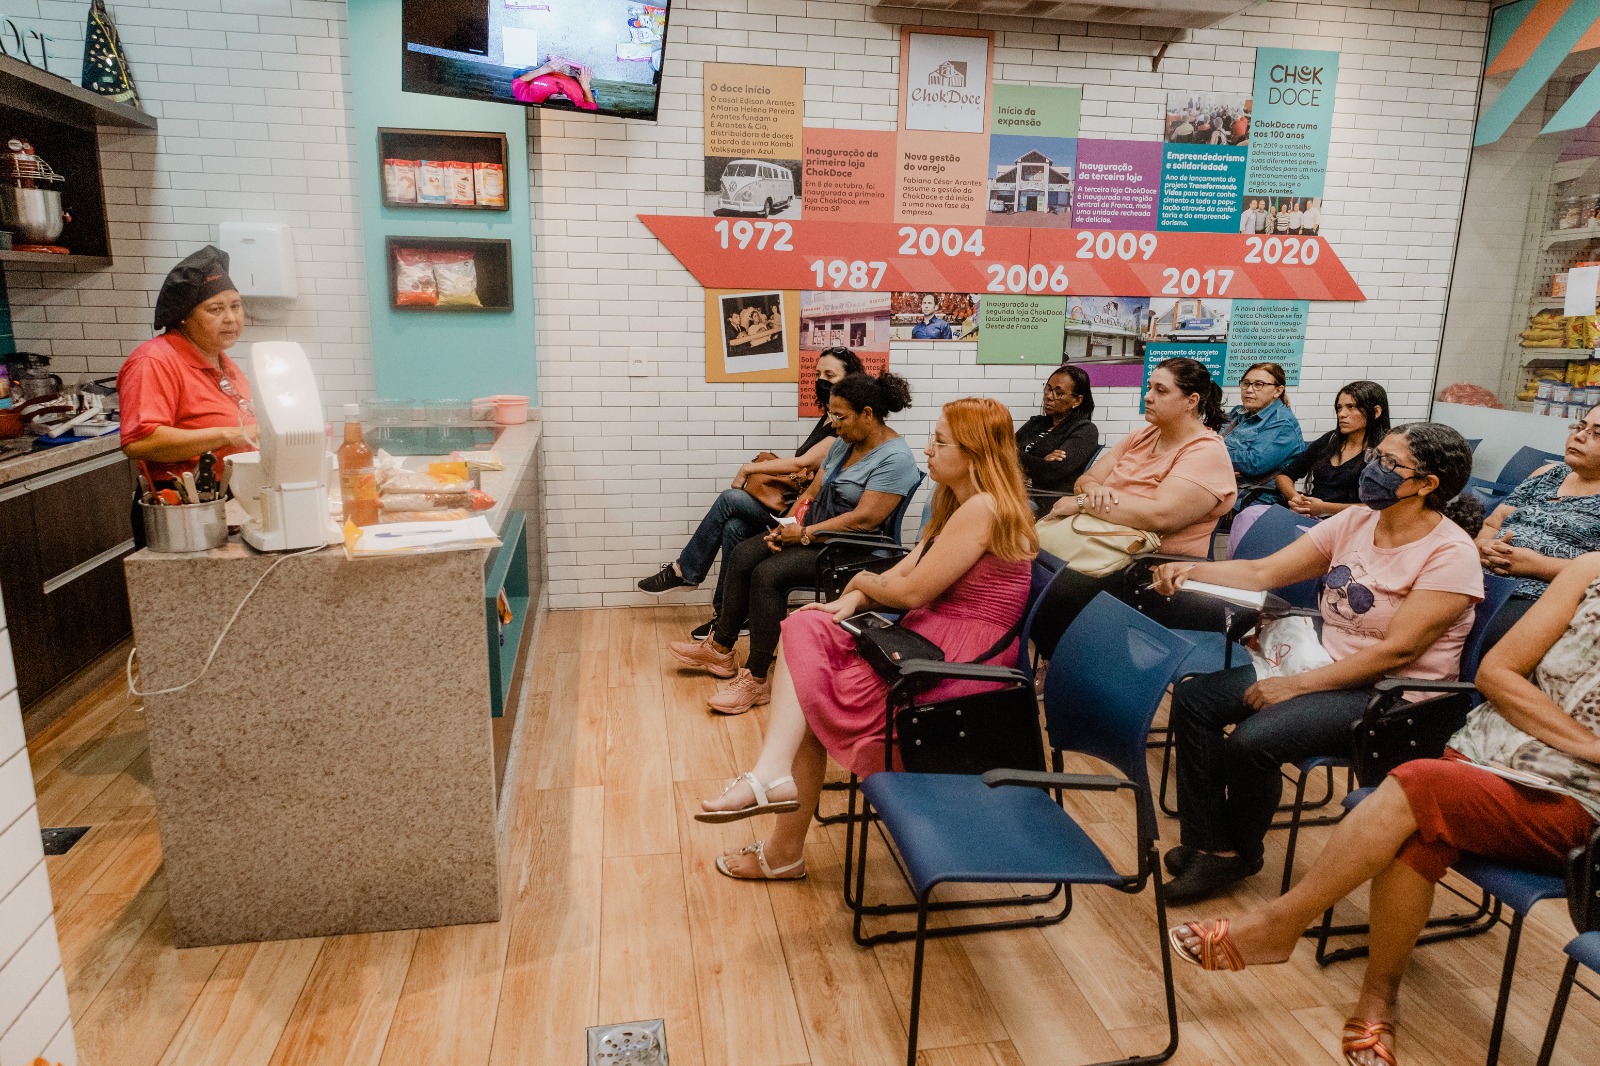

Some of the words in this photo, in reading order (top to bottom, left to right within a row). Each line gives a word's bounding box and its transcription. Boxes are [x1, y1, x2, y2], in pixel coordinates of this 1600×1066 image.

[720, 83, 742, 92] doce
[745, 85, 770, 94] início
[912, 88, 980, 104] ChokDoce
[1268, 87, 1321, 106] DOCE
[765, 98, 795, 106] Arantes
[998, 105, 1022, 114] Início
[1024, 106, 1035, 115] da
[710, 112, 740, 120] Arantes
[997, 117, 1041, 128] expansão
[1254, 120, 1295, 128] ChokDoce
[710, 129, 759, 137] distribuidora
[710, 146, 755, 155] Volkswagen
[806, 146, 864, 158] Inauguração
[904, 152, 927, 160] Nova
[929, 153, 960, 164] gestão
[1166, 151, 1245, 163] Empreendedorismo
[806, 157, 845, 168] primeira
[848, 159, 864, 169] loja
[917, 163, 945, 173] varejo
[1079, 161, 1133, 173] Inauguração
[1172, 161, 1228, 170] solidariedade
[805, 168, 852, 177] ChokDoce
[1091, 171, 1125, 180] terceira
[1126, 173, 1142, 183] loja
[903, 176, 931, 184] Fabiano
[1188, 174, 1226, 183] lançamento
[937, 186, 961, 194] gestão
[1164, 181, 1187, 190] projeto
[1188, 182, 1237, 190] Transformando
[804, 189, 846, 197] inaugurada
[902, 192, 937, 200] ChokDoce
[1082, 193, 1120, 201] inaugurada
[1131, 195, 1152, 203] região
[804, 196, 817, 204] loja
[714, 220, 794, 251] 1972
[898, 227, 985, 256] 2004
[1076, 231, 1158, 260] 2009
[1244, 236, 1320, 266] 2020
[810, 260, 888, 289] 1987
[986, 263, 1069, 293] 2006
[1161, 268, 1234, 295] 2017
